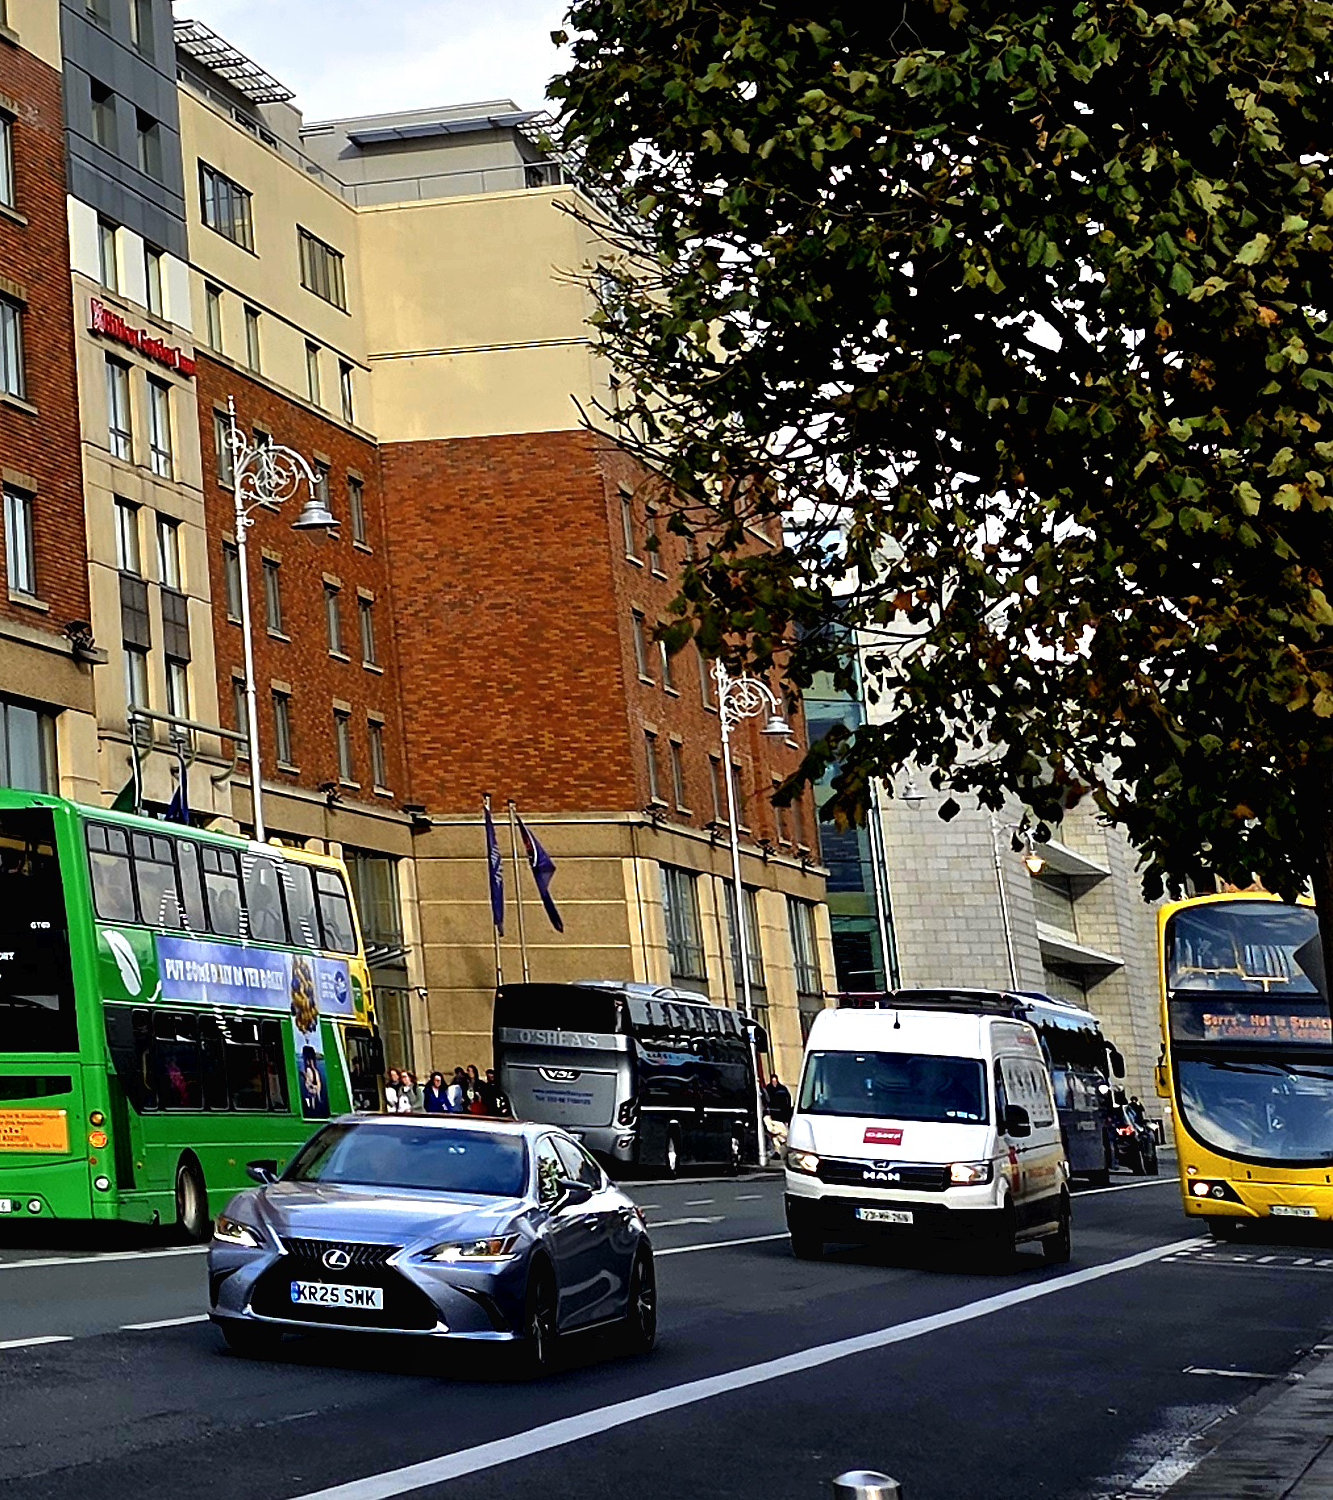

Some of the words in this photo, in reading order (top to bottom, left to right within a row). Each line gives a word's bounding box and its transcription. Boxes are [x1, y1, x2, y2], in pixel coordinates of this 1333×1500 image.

[165, 958, 184, 981] PUT
[520, 1030, 598, 1049] O'SHEA'S
[863, 1170, 900, 1182] MAN
[299, 1284, 340, 1304] KR25
